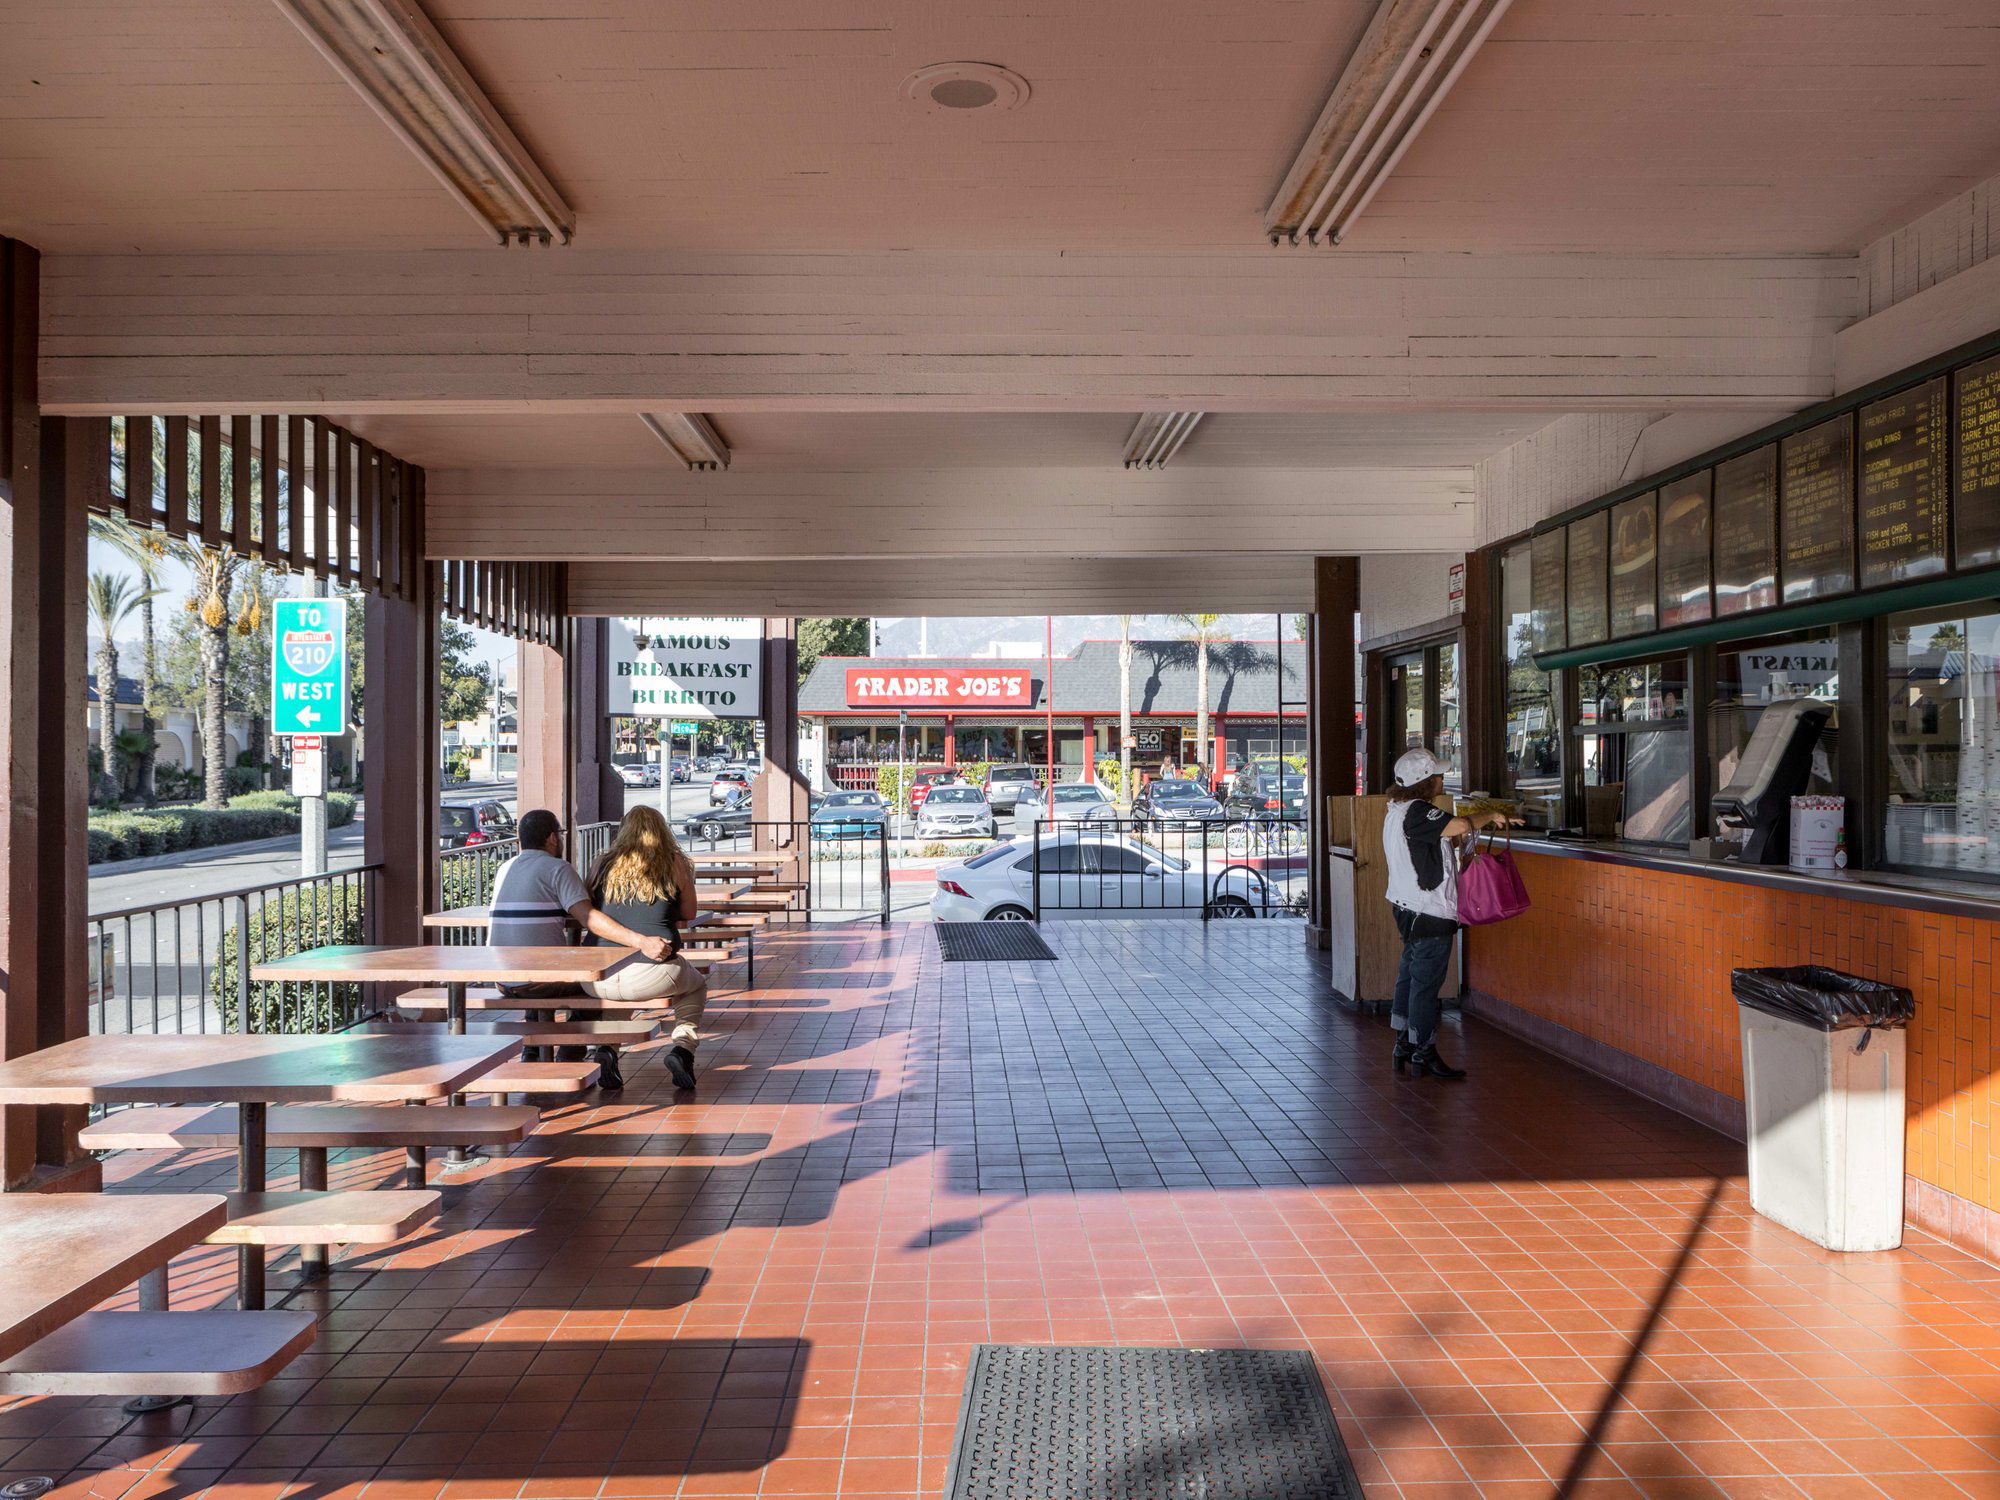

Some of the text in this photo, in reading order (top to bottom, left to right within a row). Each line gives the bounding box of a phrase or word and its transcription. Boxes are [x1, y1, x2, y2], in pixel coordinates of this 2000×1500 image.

[1961, 387, 1989, 405] CHICKEN
[1865, 412, 1886, 428] FRENCH
[1888, 405, 1905, 420] FRIES
[1961, 397, 1996, 418] FISH TACO
[1961, 408, 2000, 430] FISH BURRI
[1865, 437, 1882, 451] ONION
[1884, 430, 1901, 445] RINGS
[1962, 421, 2000, 442] CARNE ASAD
[1962, 438, 1990, 455] CHICKEN
[1962, 447, 2000, 468] BEAN BURR
[1991, 460, 2000, 472] CH
[1882, 477, 1898, 491] FRIES
[1962, 473, 2000, 492] BEEF TAQUI
[1866, 504, 1886, 519] CHEESE
[1889, 499, 1905, 512] FRIES
[1866, 529, 1878, 541] FISH
[1891, 521, 1908, 535] CHIPS
[1866, 538, 1889, 553] CHICKEN
[1891, 532, 1911, 547] STRIPS
[297, 608, 321, 627] TO
[651, 634, 731, 650] AMOUS
[291, 647, 326, 665] 210
[617, 661, 751, 678] BREAKFAST
[281, 682, 335, 701] WEST
[854, 677, 1022, 697] TRADER JOE'S
[632, 690, 736, 706] BURRITO
[1139, 733, 1159, 745] 50
